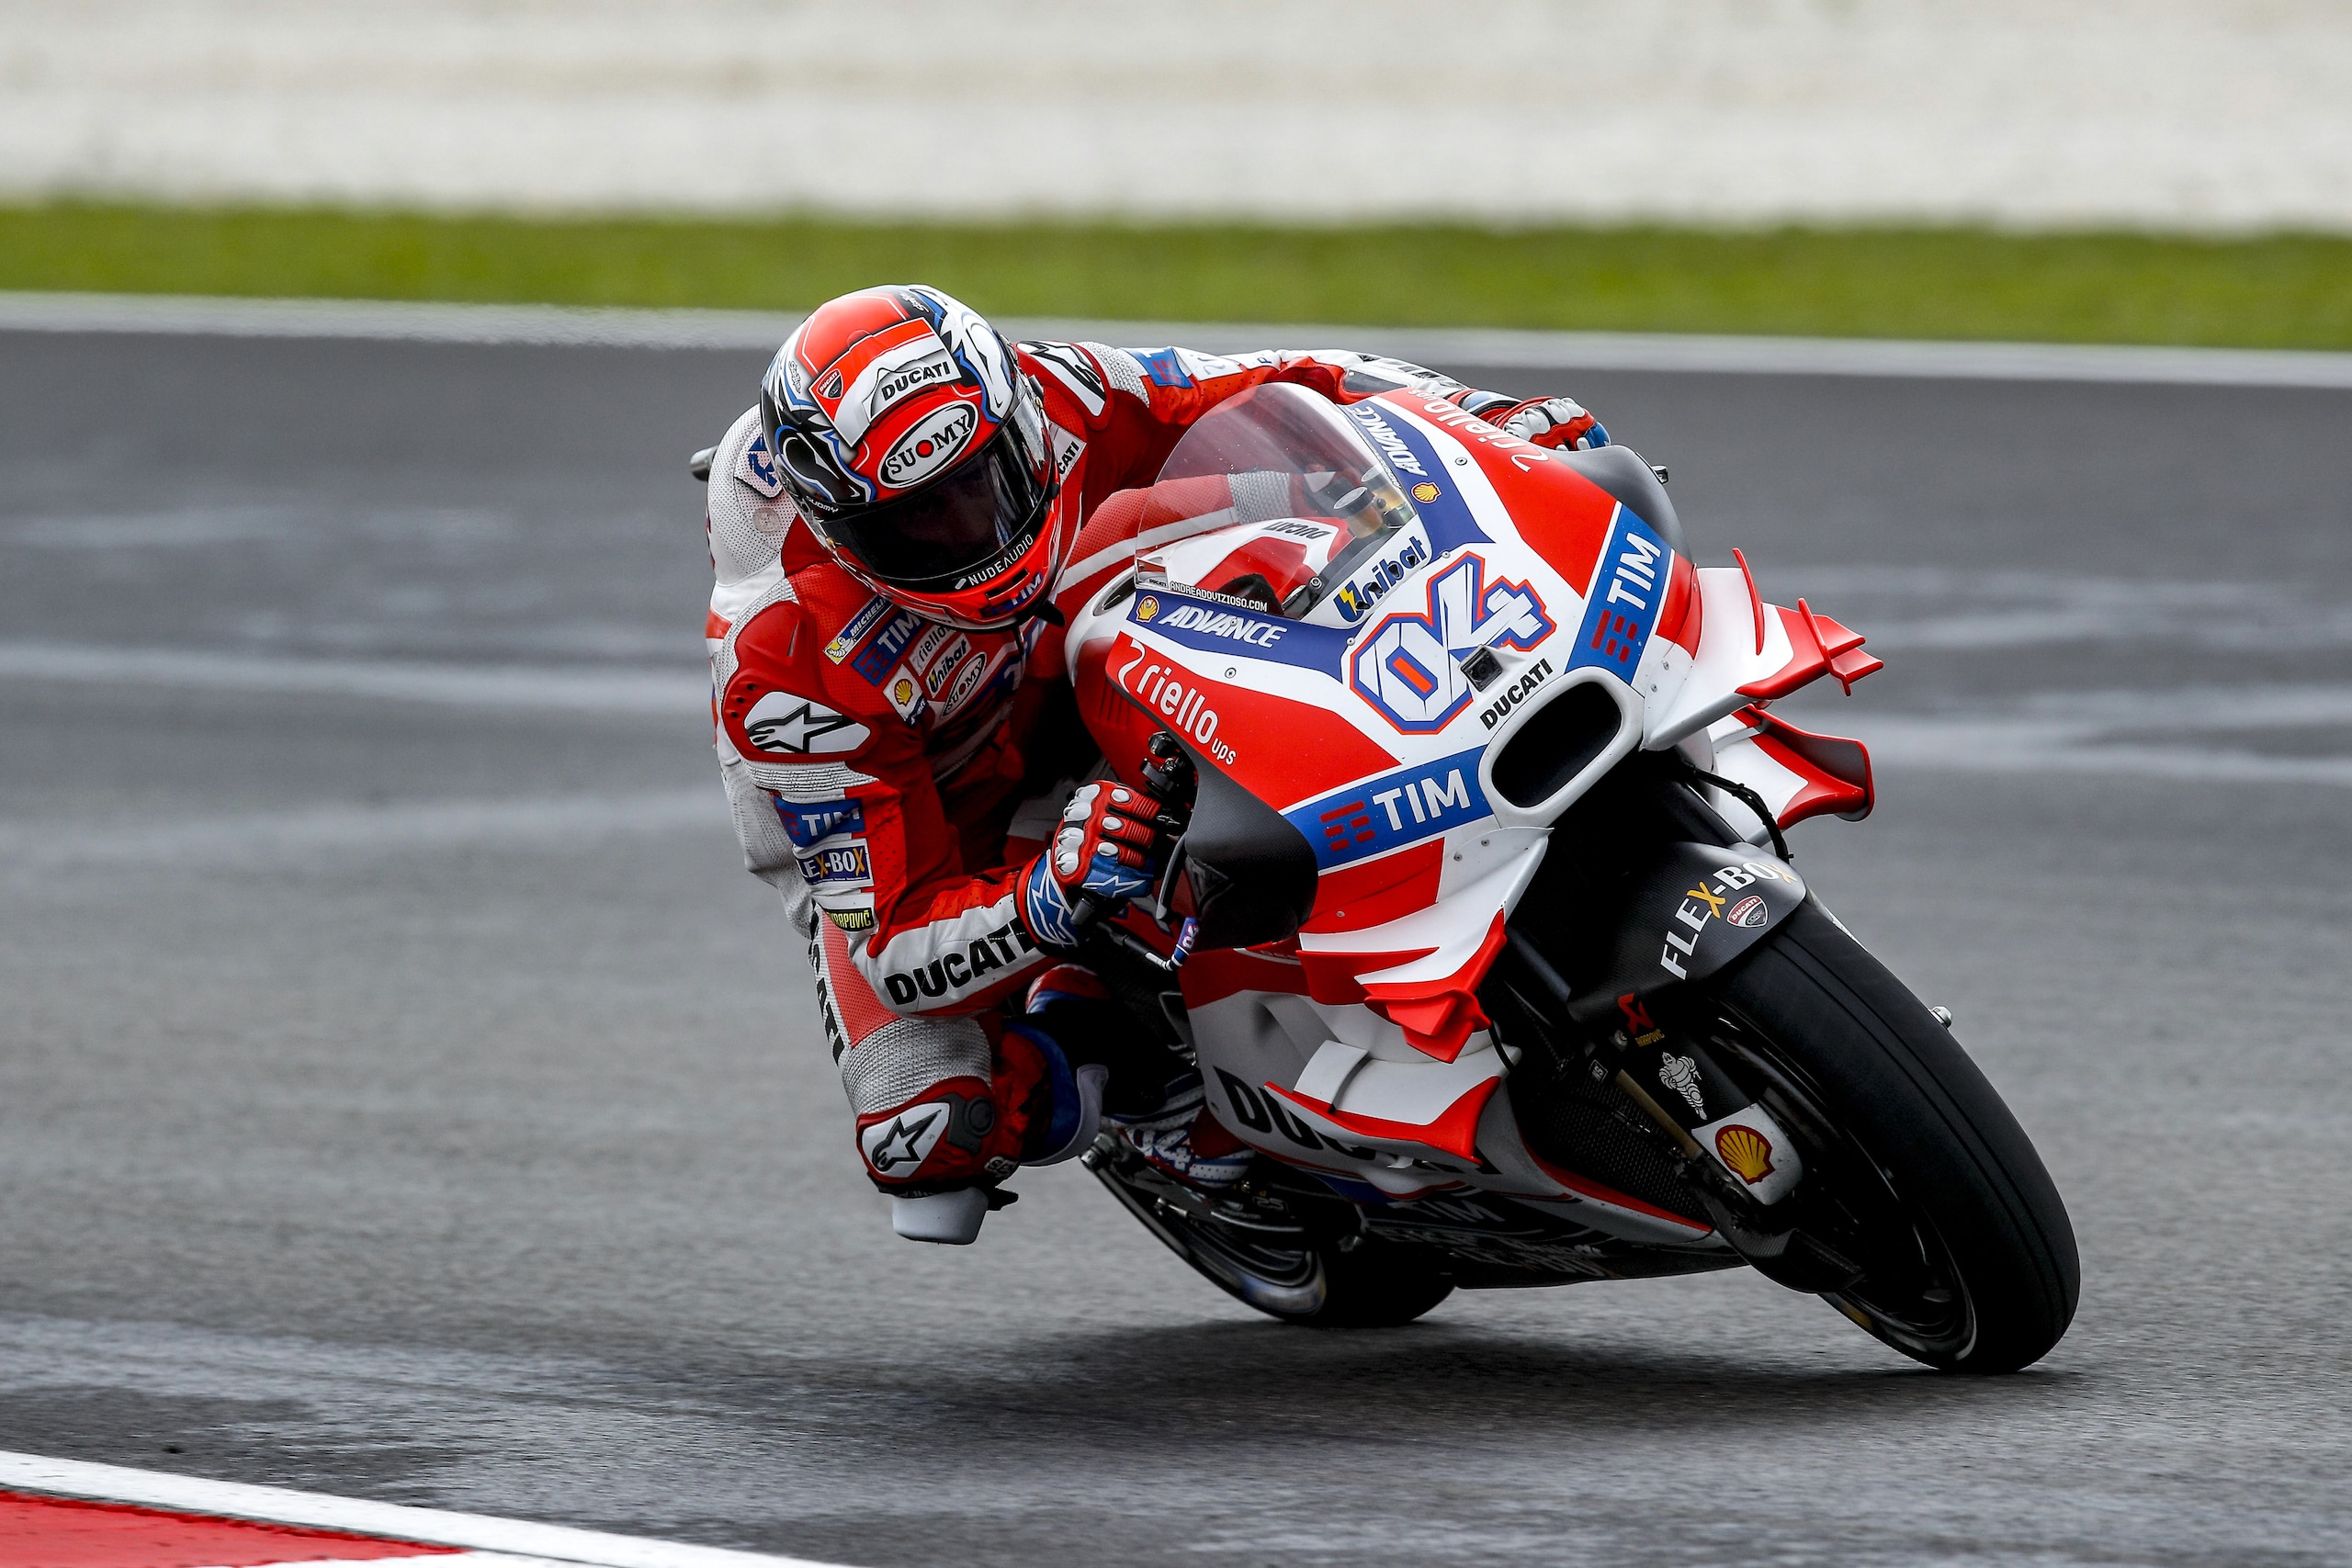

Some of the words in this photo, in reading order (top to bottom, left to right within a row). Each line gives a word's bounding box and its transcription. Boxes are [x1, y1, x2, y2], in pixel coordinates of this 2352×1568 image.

[820, 371, 838, 392] DUCATI
[881, 361, 951, 401] DUCATI
[887, 413, 971, 475] SUOMY
[1346, 405, 1429, 477] ADVANCE
[1423, 401, 1525, 450] riello
[1057, 441, 1080, 474] CATI
[1262, 521, 1332, 539] DUCATI
[1170, 581, 1268, 613] ANDREADOVIZIOSO.COM
[1333, 536, 1428, 622] Unibat
[1606, 532, 1662, 611] TIM
[877, 611, 921, 654] TIM
[1158, 604, 1288, 650] ADVANCE
[1350, 550, 1557, 735] 04
[947, 660, 982, 711] SUOMY
[1480, 658, 1555, 730] DUCATI
[1136, 660, 1219, 744] riello
[1212, 736, 1238, 766] ups
[1373, 768, 1471, 831] TIM
[796, 848, 865, 880] LEX-BOX
[1660, 862, 1798, 981] FLEX-BOX
[1731, 897, 1758, 921] DUCATI
[883, 916, 1038, 1006] DUCATI
